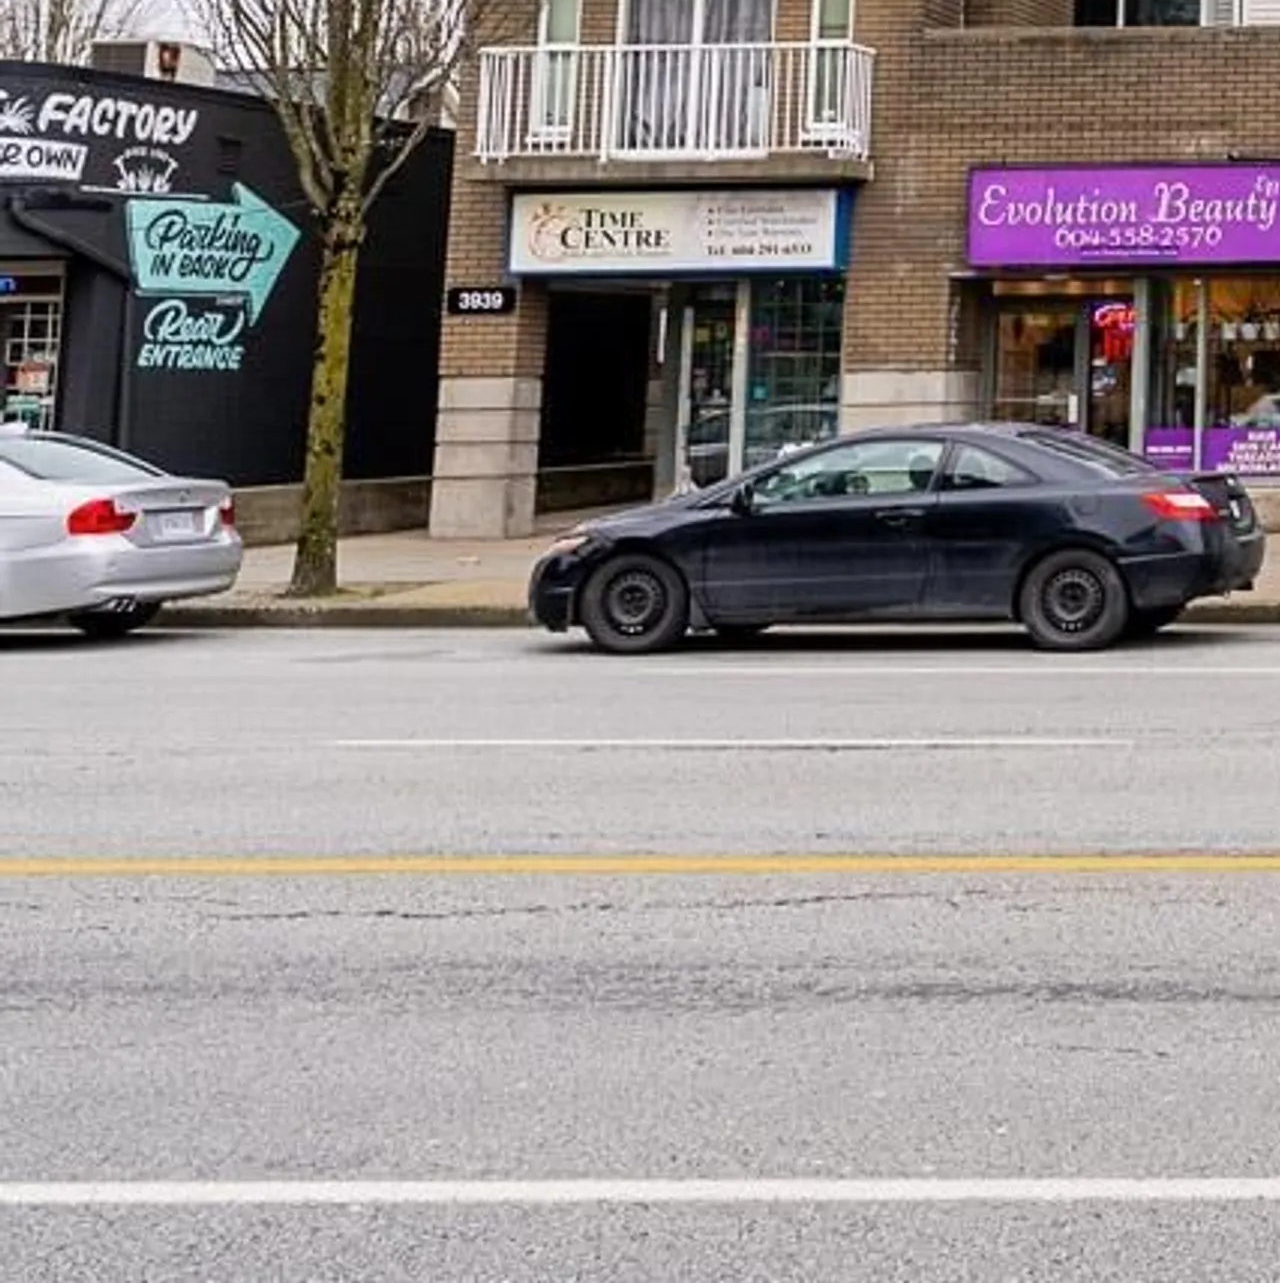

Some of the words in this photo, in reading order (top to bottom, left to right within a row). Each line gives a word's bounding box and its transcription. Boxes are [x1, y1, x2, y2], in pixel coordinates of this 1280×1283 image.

[37, 92, 198, 145] FACTORY
[579, 208, 643, 229] TIME
[978, 184, 1138, 226] Evolution
[1149, 182, 1277, 231] Beauty
[145, 209, 275, 282] Parking
[560, 225, 670, 249] CENTRE
[150, 252, 176, 277] IN
[178, 253, 230, 280] BACK
[458, 291, 503, 309] 3939
[144, 298, 245, 345] Rear
[137, 344, 244, 370] ENTRANCE
